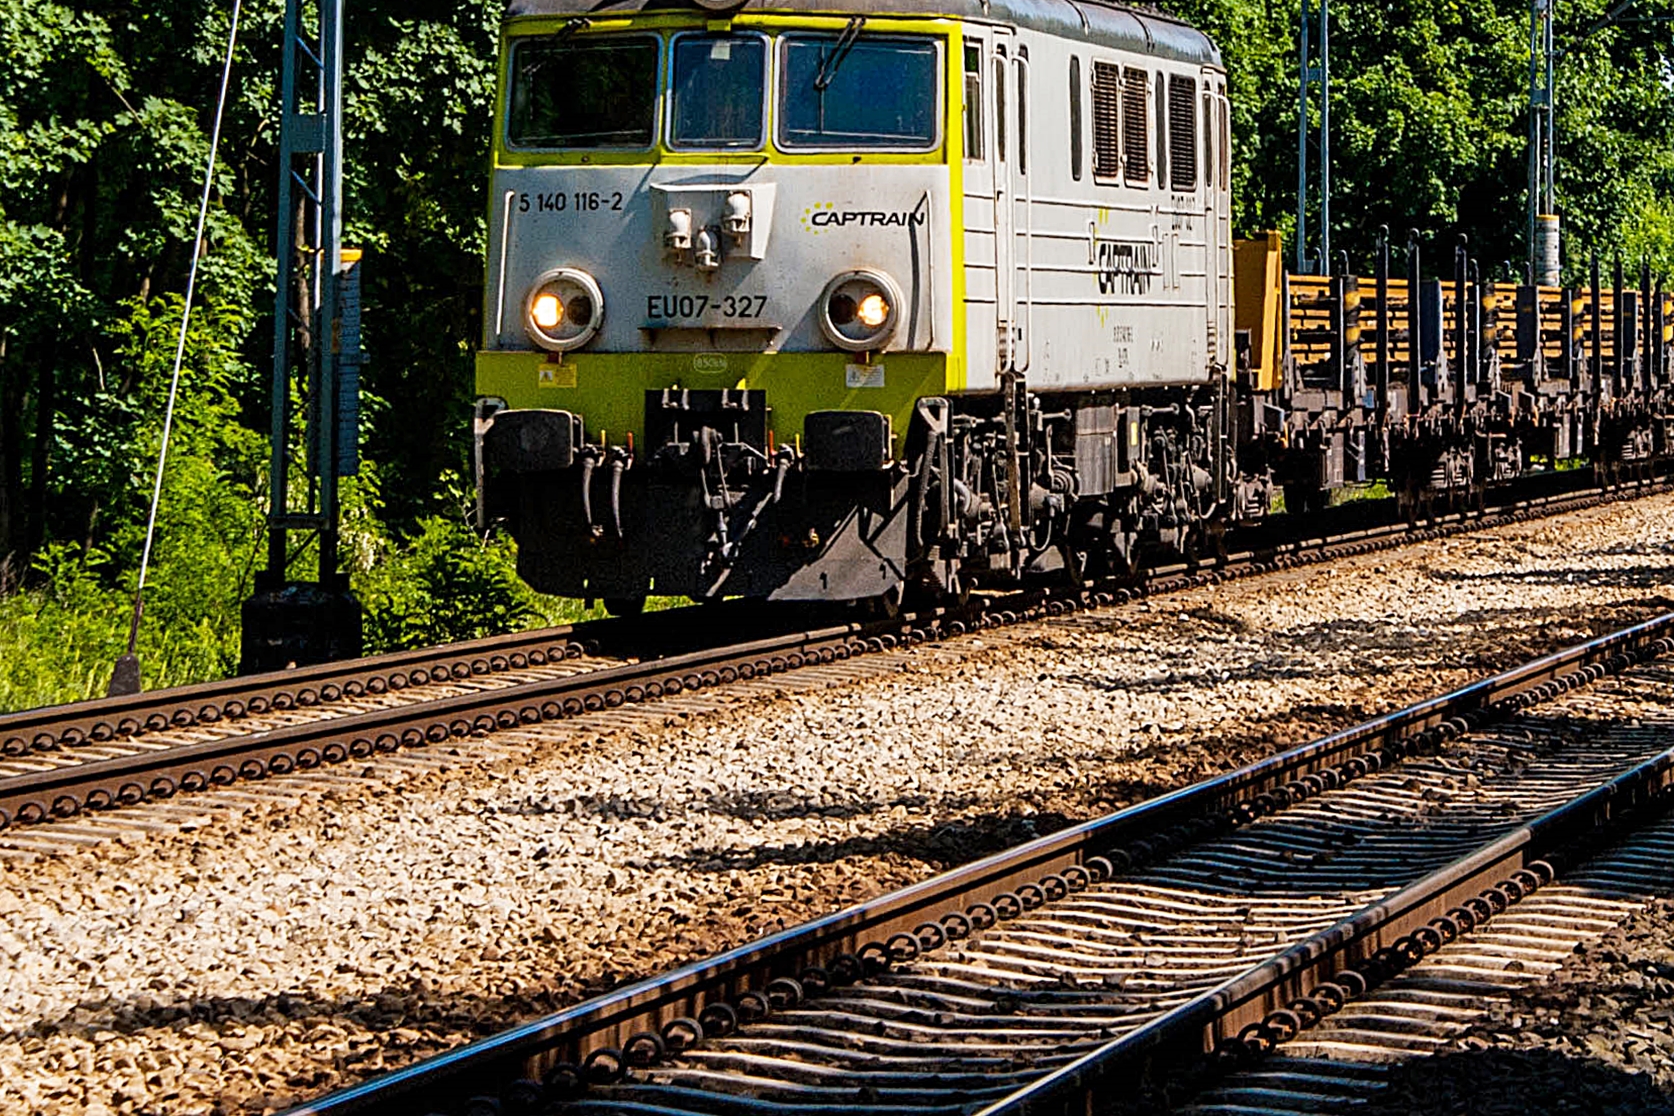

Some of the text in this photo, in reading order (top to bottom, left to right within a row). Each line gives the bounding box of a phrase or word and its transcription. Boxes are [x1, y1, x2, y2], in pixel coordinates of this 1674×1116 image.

[519, 191, 622, 212] 5 140 116-2
[811, 212, 925, 226] CAPTRAIN
[647, 295, 767, 318] EU07-327
